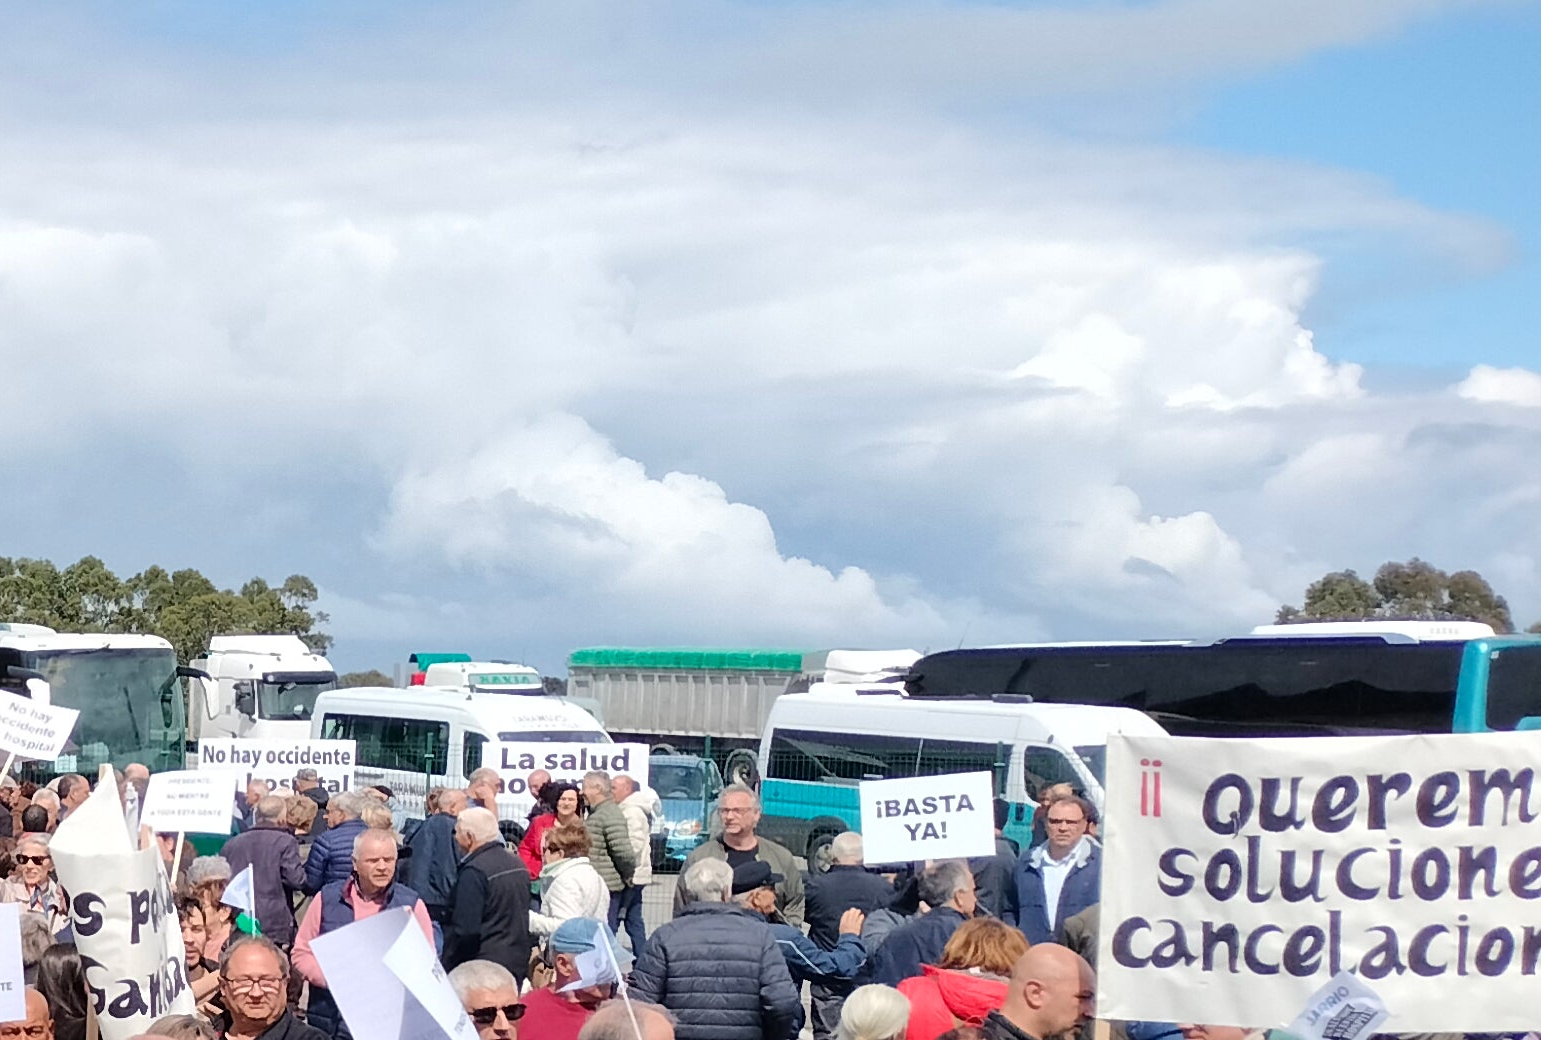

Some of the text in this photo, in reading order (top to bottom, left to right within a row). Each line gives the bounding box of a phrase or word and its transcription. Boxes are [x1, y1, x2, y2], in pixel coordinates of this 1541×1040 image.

[9, 702, 53, 725] No hay
[4, 732, 55, 752] hospital
[203, 745, 351, 768] No hay occidente
[501, 747, 630, 771] La salud
[875, 794, 975, 818] ¡BASTA
[904, 821, 948, 841] YA!
[1306, 986, 1350, 1027] JARRIO
